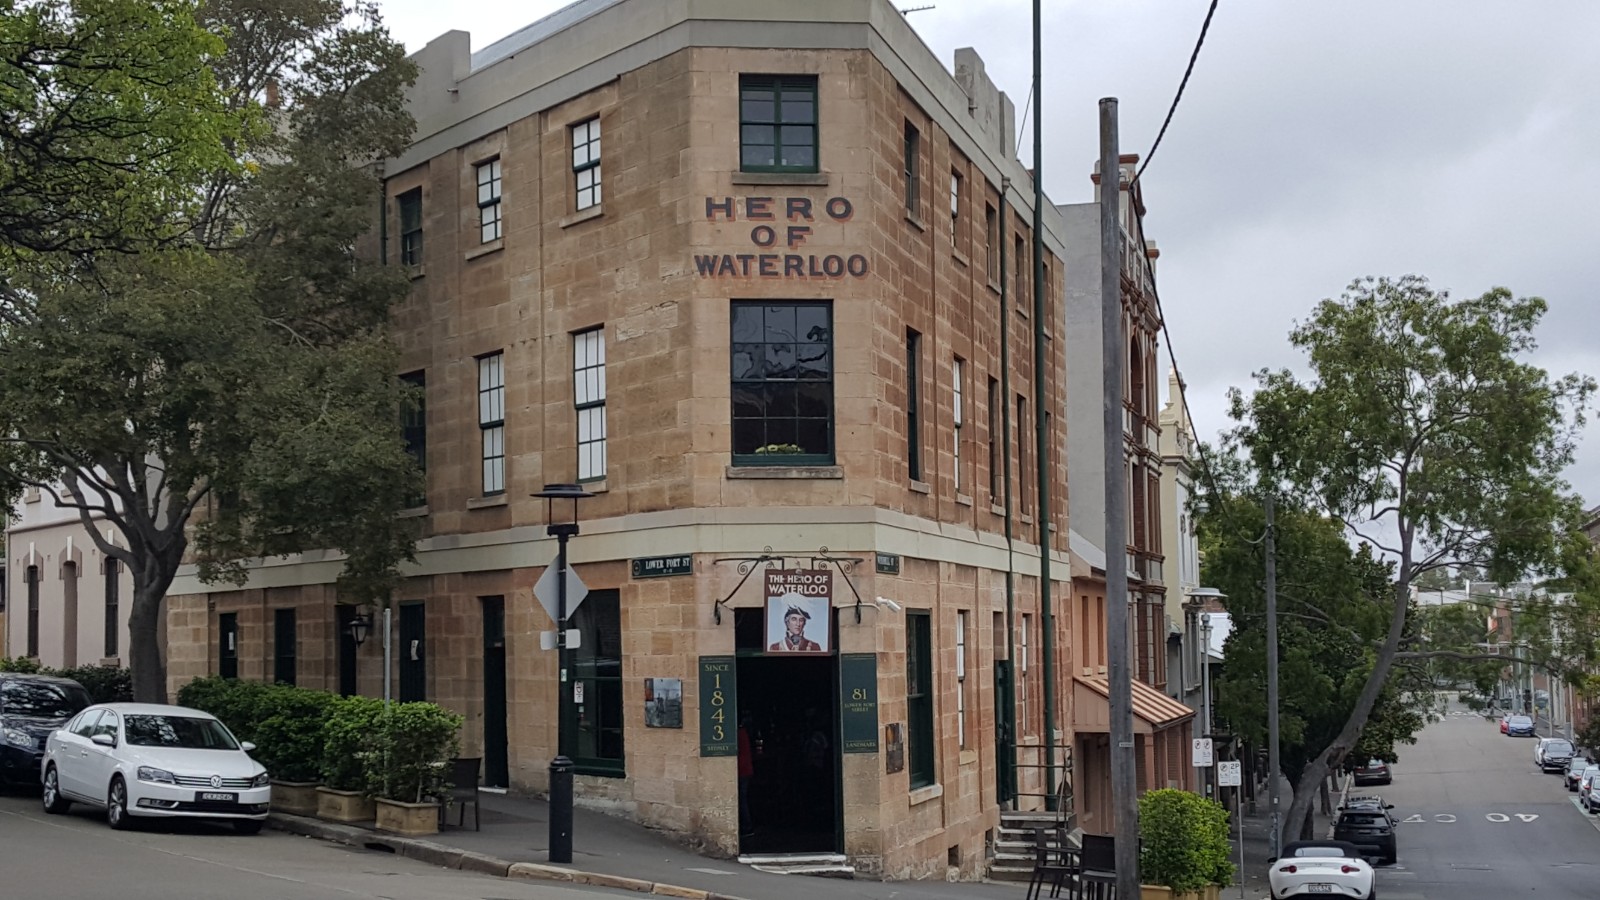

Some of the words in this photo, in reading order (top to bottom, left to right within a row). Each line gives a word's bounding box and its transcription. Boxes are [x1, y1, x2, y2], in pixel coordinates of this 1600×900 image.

[705, 197, 853, 222] HERO
[751, 225, 812, 248] OF
[694, 254, 870, 280] WATERLOO
[645, 559, 665, 570] LOWER
[666, 558, 681, 568] FORT
[682, 557, 690, 567] ST
[768, 574, 785, 584] THE
[814, 574, 828, 584] OF
[768, 584, 828, 594] WATERLOO
[852, 688, 867, 700] 81
[711, 673, 725, 741] 1843
